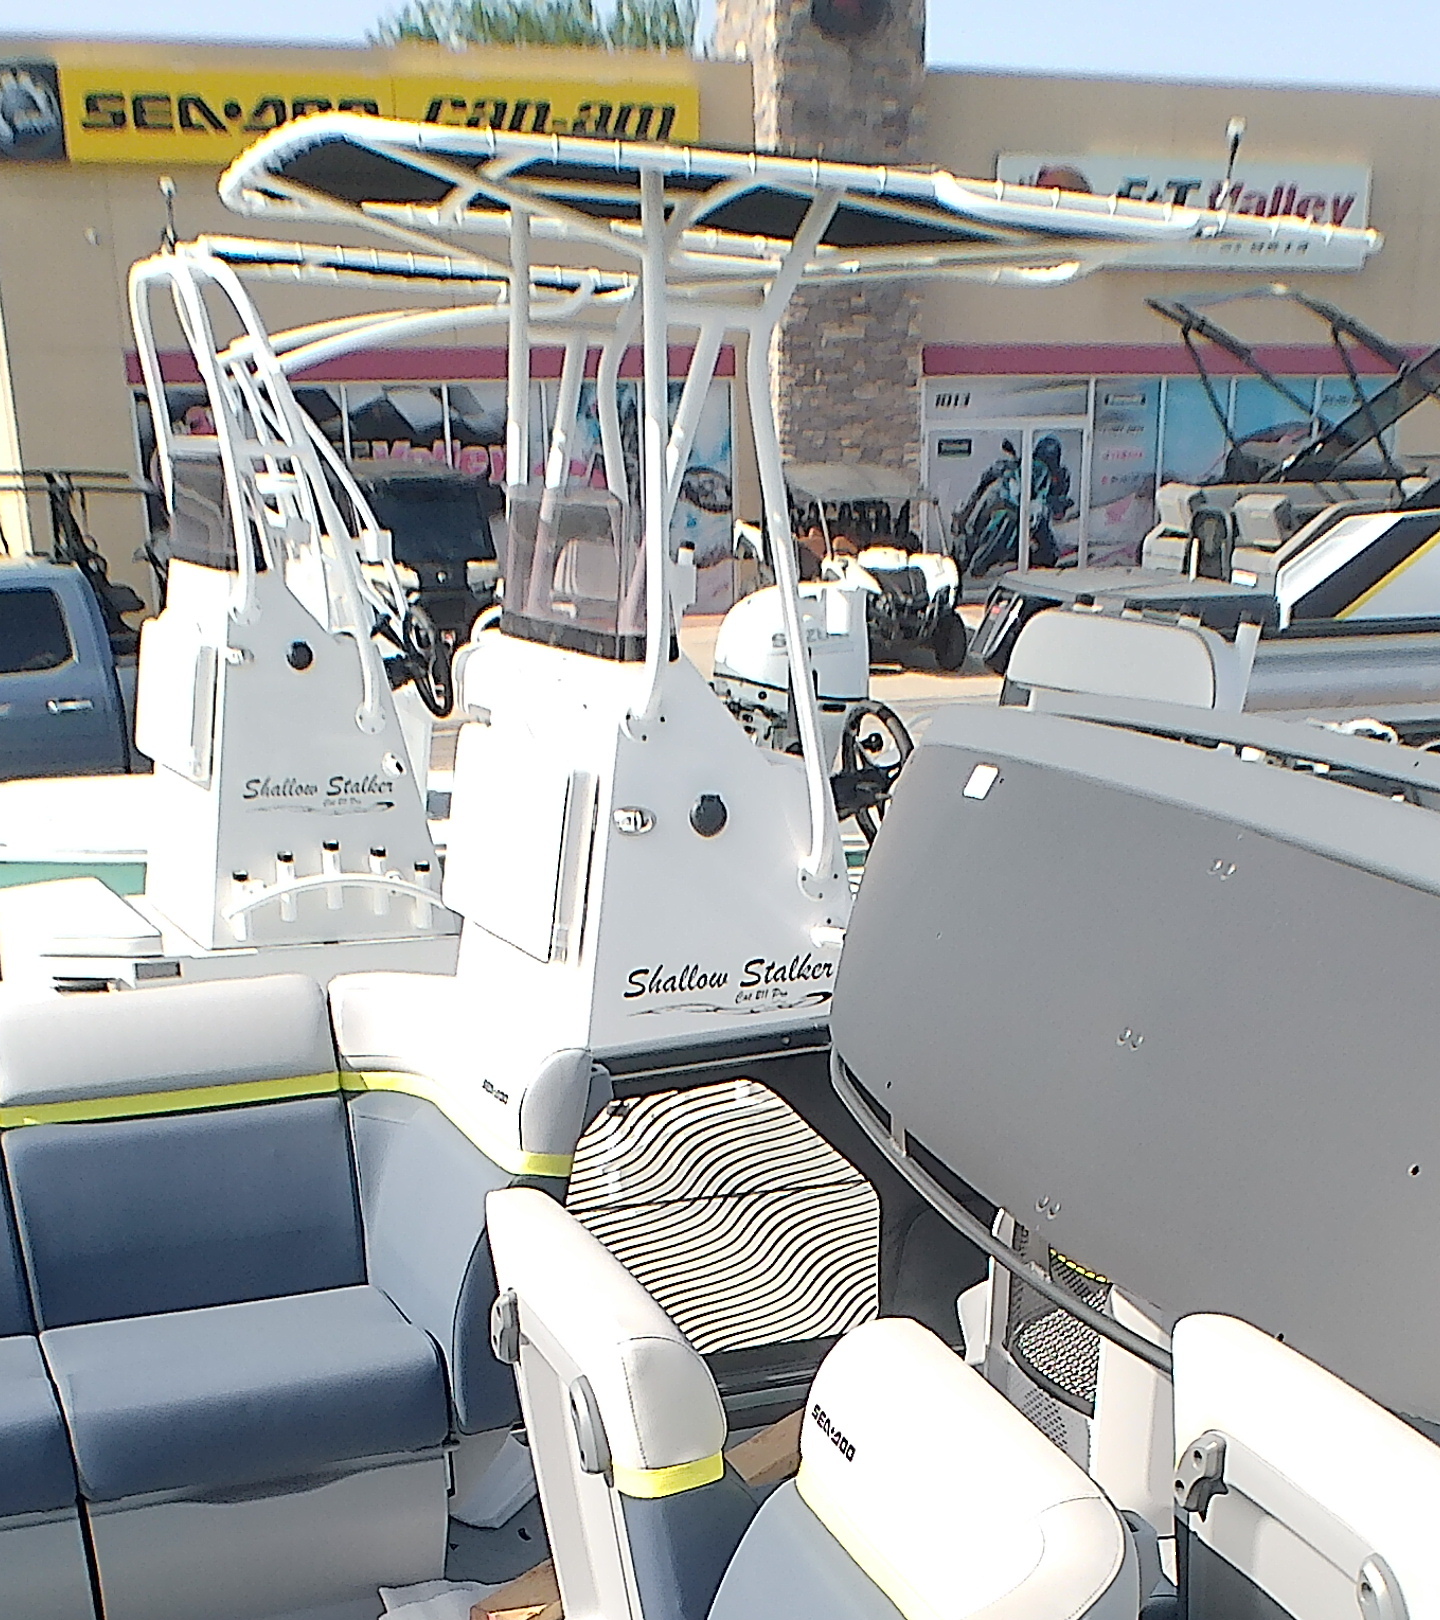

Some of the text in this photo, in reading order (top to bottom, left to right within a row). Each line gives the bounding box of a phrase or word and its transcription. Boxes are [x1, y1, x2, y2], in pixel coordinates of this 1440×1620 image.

[242, 773, 393, 799] Shallow Stalker
[623, 952, 834, 998] Shallow Stalker
